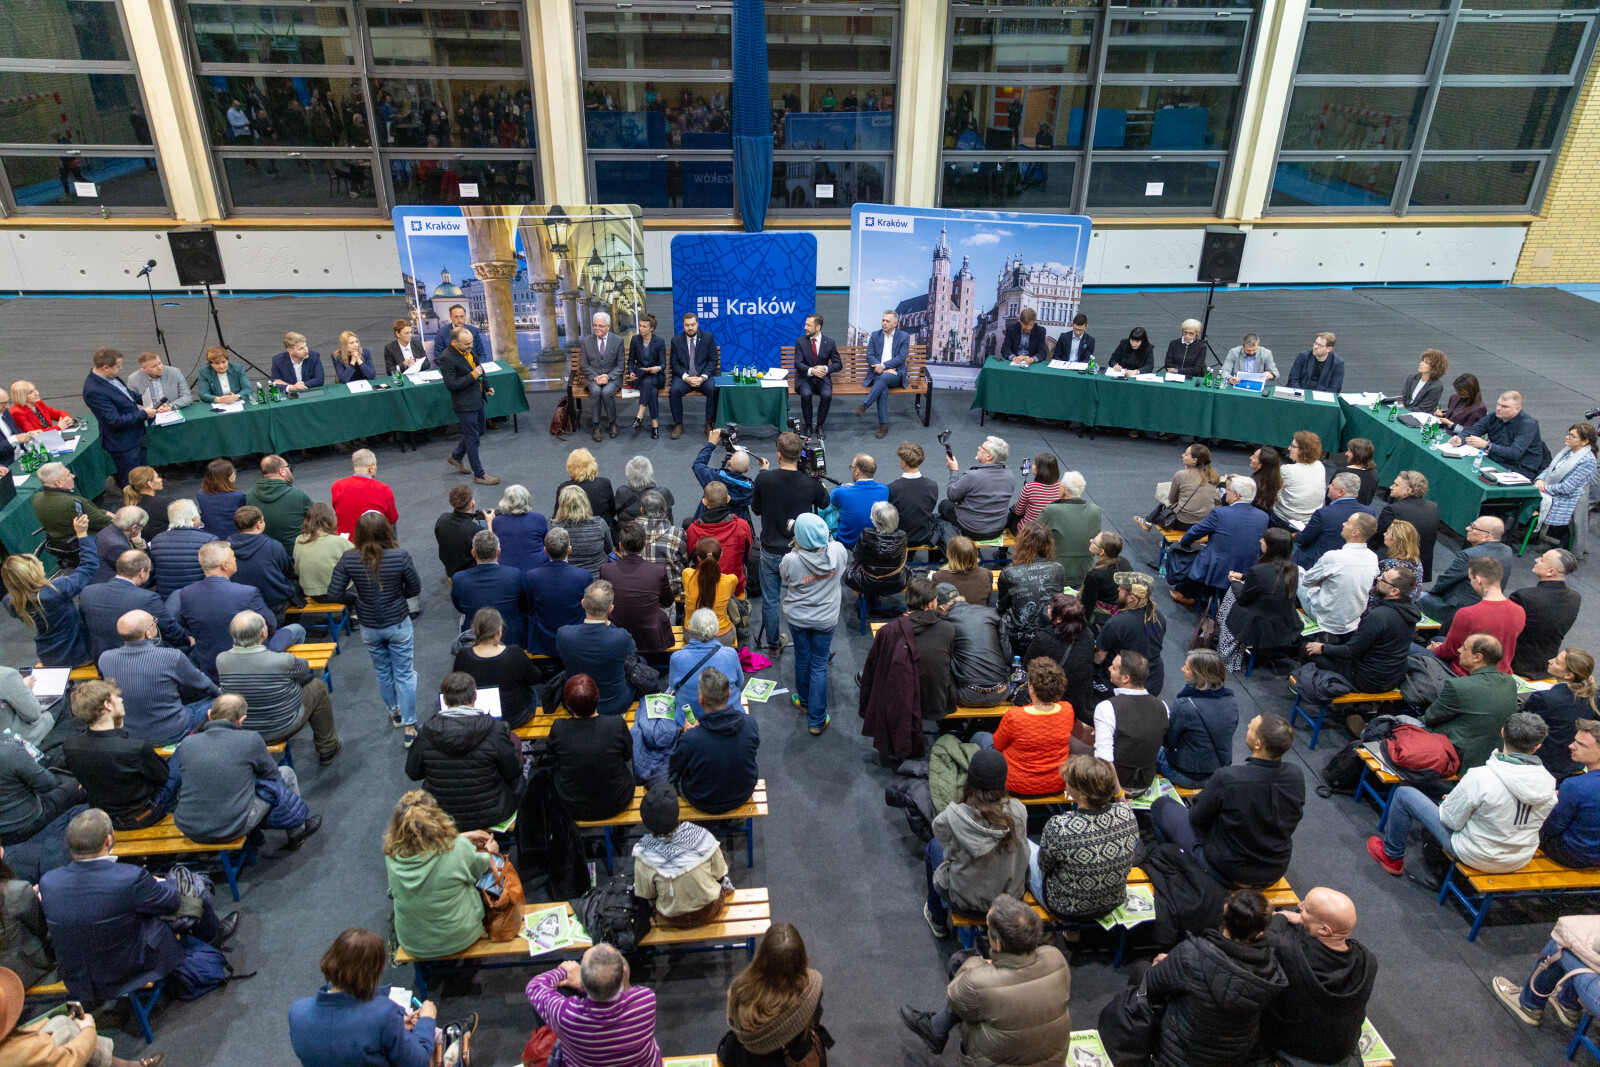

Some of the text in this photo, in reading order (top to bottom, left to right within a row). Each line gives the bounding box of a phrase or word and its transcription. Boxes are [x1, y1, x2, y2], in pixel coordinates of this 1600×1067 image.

[425, 221, 460, 231] Kraków
[877, 219, 908, 228] Kraków
[726, 296, 796, 315] Kraków
